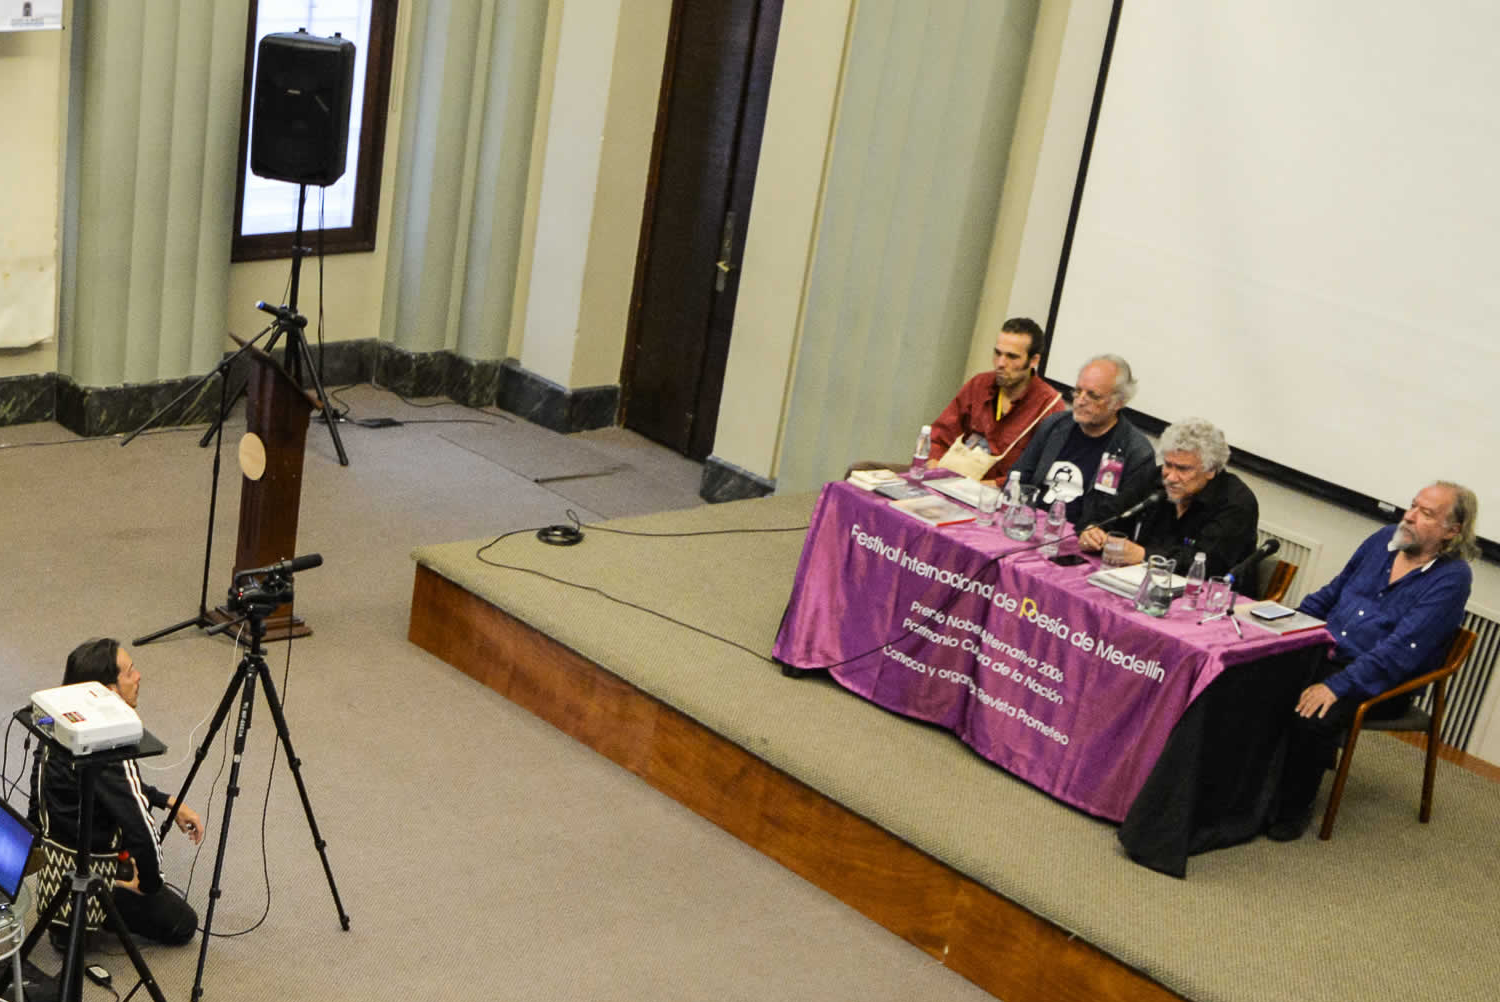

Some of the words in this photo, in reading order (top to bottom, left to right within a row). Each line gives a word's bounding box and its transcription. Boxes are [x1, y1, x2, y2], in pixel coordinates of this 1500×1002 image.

[851, 524, 900, 563] Festival
[993, 592, 1018, 613] de
[1070, 631, 1095, 652] de
[1095, 639, 1166, 683] Medellín
[883, 644, 926, 673] Convoca
[927, 666, 937, 678] y
[977, 688, 1017, 717] Revista
[1016, 708, 1069, 745] Prometeo
[991, 661, 1011, 676] de
[1010, 669, 1024, 682] la
[1023, 675, 1064, 705] Nación
[1037, 661, 1064, 682] 2006
